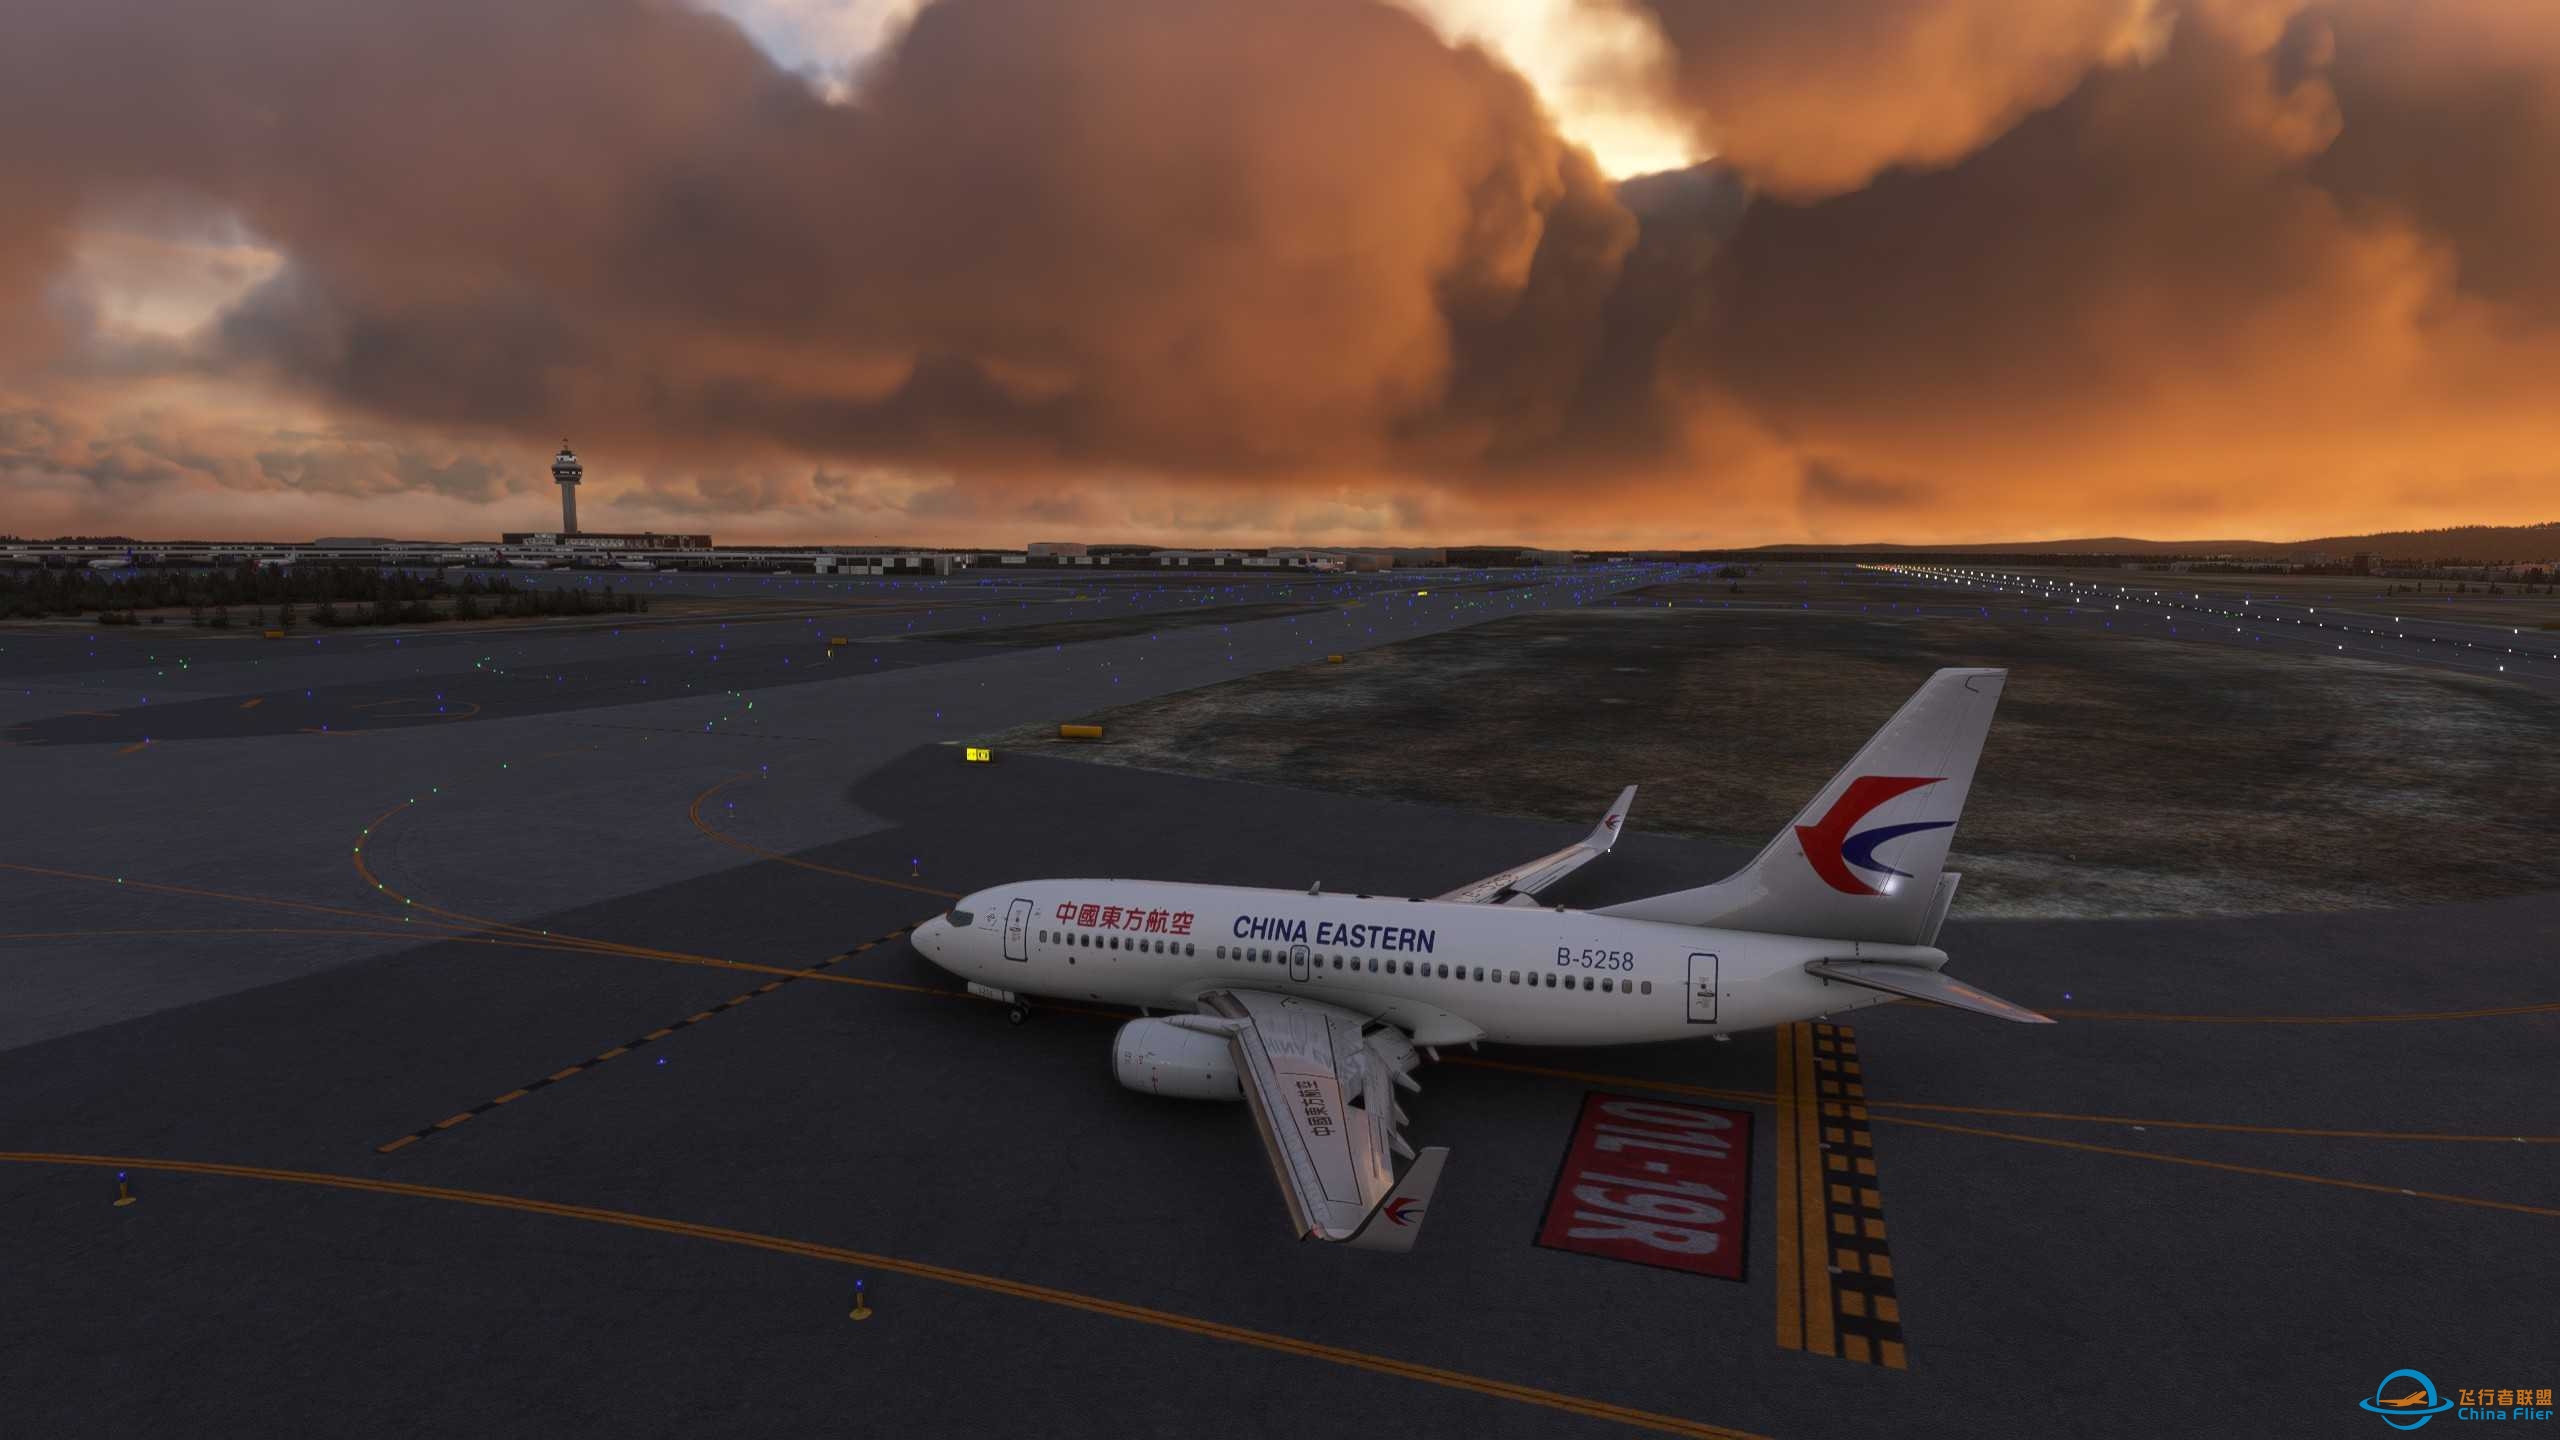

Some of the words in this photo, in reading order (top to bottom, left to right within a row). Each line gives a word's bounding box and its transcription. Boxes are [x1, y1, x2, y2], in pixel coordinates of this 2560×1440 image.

[1056, 901, 1194, 935] 中國東方航空
[1233, 915, 1308, 943] CHINA
[1316, 921, 1436, 953] EASTERN
[1557, 947, 1634, 971] B-5258
